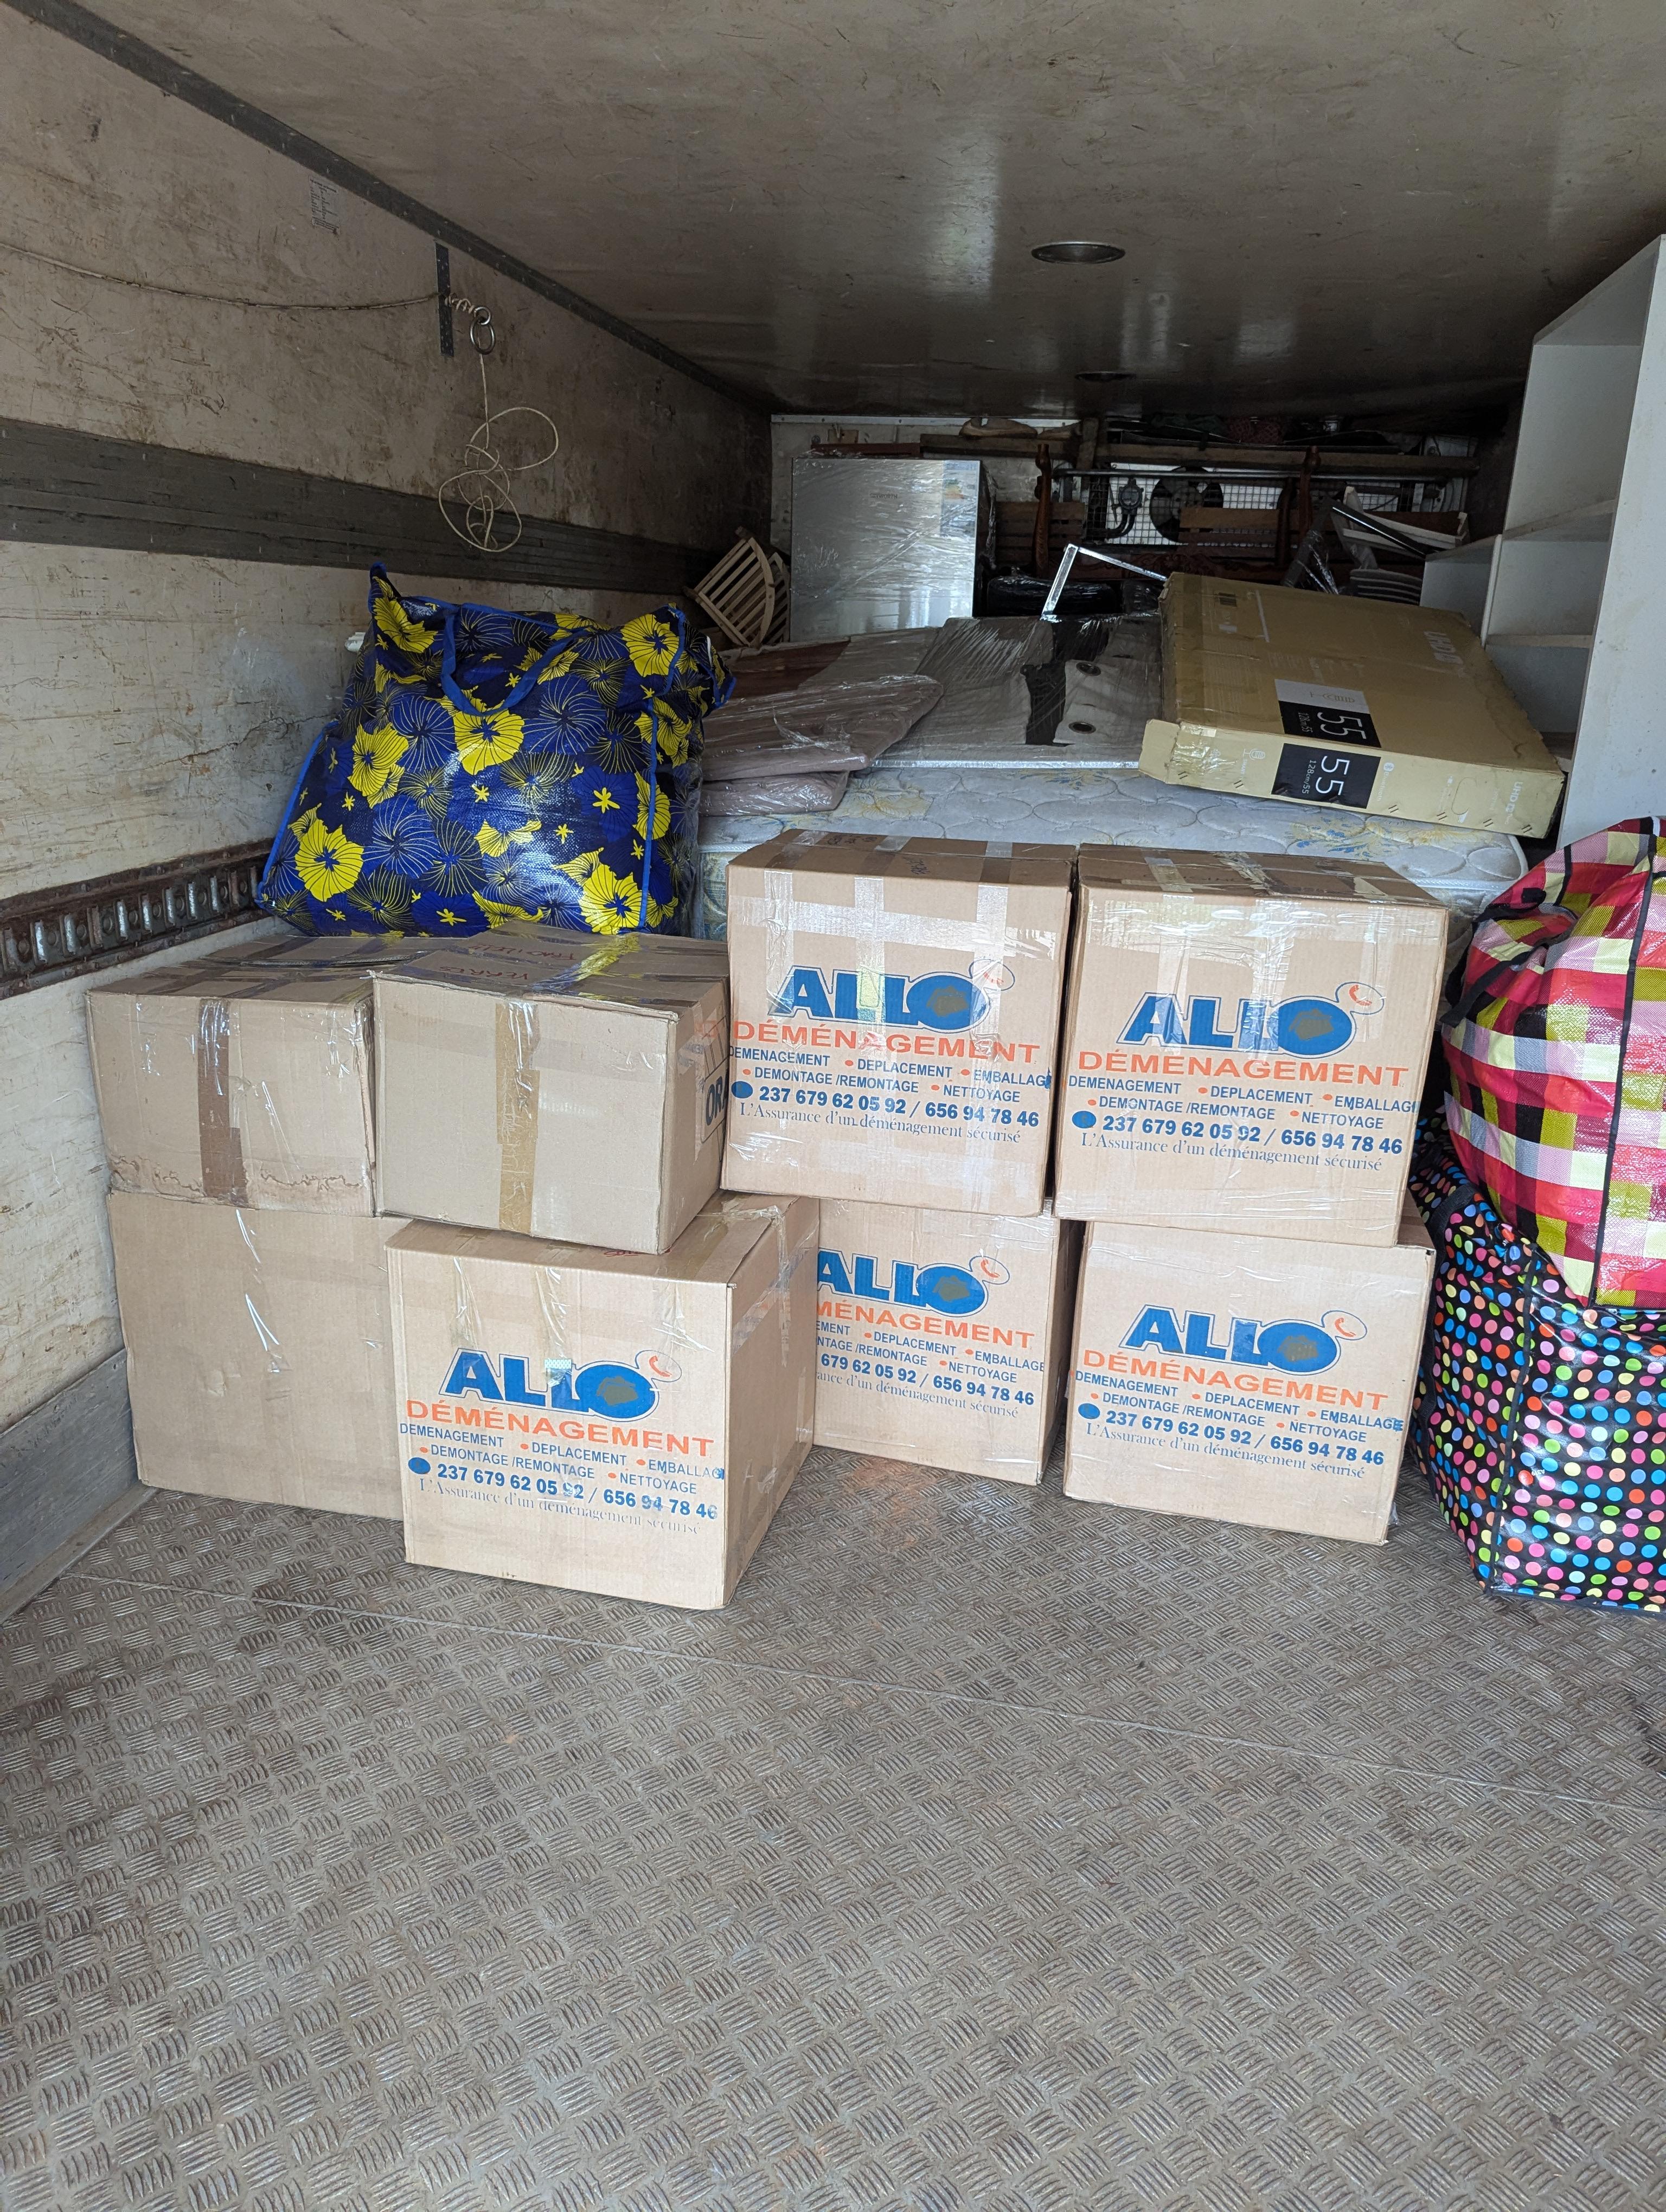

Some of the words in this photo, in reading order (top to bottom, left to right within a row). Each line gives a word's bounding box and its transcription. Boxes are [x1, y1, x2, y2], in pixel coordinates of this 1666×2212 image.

[1317, 712, 1367, 740] 55
[1302, 760, 1316, 794] 128cm/55
[1316, 755, 1350, 796] 55
[1510, 781, 1523, 802] UHD
[729, 1045, 830, 1066] DEMENAGEMENT
[857, 1059, 953, 1078] DEPLACEMENT
[973, 1069, 1052, 1089] EMBALLAG
[754, 1066, 832, 1084] DEMONTAGE
[836, 1074, 919, 1094] /REMONTAGE
[943, 1084, 1021, 1103] NETTOYAGE
[759, 1086, 791, 1103] 237
[796, 1089, 828, 1106] 679
[832, 1094, 854, 1110] 62
[858, 1096, 880, 1111] 05
[885, 1098, 906, 1114] 92
[925, 1103, 958, 1120] 656
[963, 1105, 984, 1122] 94
[991, 1108, 1012, 1124] 78
[1017, 1110, 1039, 1127] 46
[1068, 1075, 1181, 1095] DEMENAGEMENT
[1210, 1086, 1313, 1105] DEPLACEMENT
[1099, 1095, 1183, 1114] DEMONTAGE
[1186, 1102, 1276, 1121] /REMONTAGE
[1302, 1111, 1385, 1129] NETTOYAGE
[740, 1102, 821, 1123] L'Assurance
[825, 1111, 856, 1126] d'un
[860, 1115, 963, 1139] déménagement
[966, 1127, 1021, 1143] sécurisé
[1103, 1116, 1136, 1133] 237
[1142, 1118, 1176, 1135] 679
[1181, 1121, 1204, 1137] 62
[1209, 1123, 1233, 1140] 05
[1238, 1126, 1260, 1142] 92
[1281, 1129, 1316, 1147] 656
[1321, 1133, 1345, 1149] 94
[1351, 1136, 1374, 1152] 78
[1379, 1138, 1403, 1155] 46
[1081, 1132, 1168, 1153] L'Assurance
[1172, 1139, 1205, 1156] d'un
[1209, 1143, 1320, 1166] déménagement
[1324, 1155, 1382, 1172] sécurisé
[817, 1300, 1035, 1348] MÉNAGEMENT
[874, 1331, 957, 1356] DEPLACEMENT
[816, 1336, 853, 1352] NTAGE
[855, 1343, 927, 1366] /REMONTAGE
[949, 1361, 1017, 1383] NETTOYAGE
[821, 1353, 848, 1370] 679
[852, 1359, 871, 1374] 62
[875, 1364, 894, 1379] 05
[897, 1368, 917, 1384] 92
[933, 1375, 962, 1392] 656
[966, 1381, 986, 1397] 94
[991, 1385, 1010, 1401] 78
[1014, 1390, 1034, 1405] 46
[1084, 1349, 1388, 1411] DÉMÉNAGEMENT
[847, 1374, 872, 1390] d'un
[876, 1380, 967, 1410] déménagement
[970, 1400, 1018, 1418] sécurisé
[1075, 1370, 1178, 1397] DEMENAGEMENT
[1205, 1392, 1300, 1416] DEPLACEMENT
[406, 1399, 714, 1457] DÉMÉNAGEMENT
[1103, 1392, 1180, 1414] DEMONTAGE
[1182, 1404, 1266, 1427] /REMONTAGE
[1289, 1421, 1367, 1443] NETTOYAGE
[1106, 1410, 1137, 1427] 237
[1142, 1415, 1174, 1432] 679
[1178, 1420, 1199, 1436] 62
[1204, 1425, 1226, 1441] 05
[1230, 1429, 1252, 1444] 92
[1270, 1436, 1303, 1453] 656
[1308, 1441, 1330, 1457] 94
[1336, 1445, 1357, 1461] 78
[1361, 1450, 1385, 1465] 46
[400, 1423, 504, 1448] DEMENAGEMENT
[532, 1441, 627, 1467] DEPLACEMENT
[1086, 1422, 1166, 1448] L'Assurance
[1170, 1435, 1200, 1453] d'un
[1204, 1441, 1306, 1470] déménagement
[1311, 1459, 1365, 1479] sécurisé
[431, 1444, 508, 1467] DEMONTAGE
[511, 1455, 595, 1479] /REMONTAGE
[620, 1472, 697, 1494] NETTOYAGE
[419, 1478, 500, 1504] L'Assurance
[505, 1487, 534, 1509] d'un
[438, 1463, 469, 1481] 237
[473, 1469, 505, 1487] 679
[510, 1474, 531, 1491] 62
[536, 1478, 558, 1495] 05
[563, 1482, 584, 1500] 92
[603, 1489, 636, 1507] 656
[642, 1495, 662, 1512] 94
[669, 1499, 690, 1515] 78
[696, 1503, 718, 1520] 46
